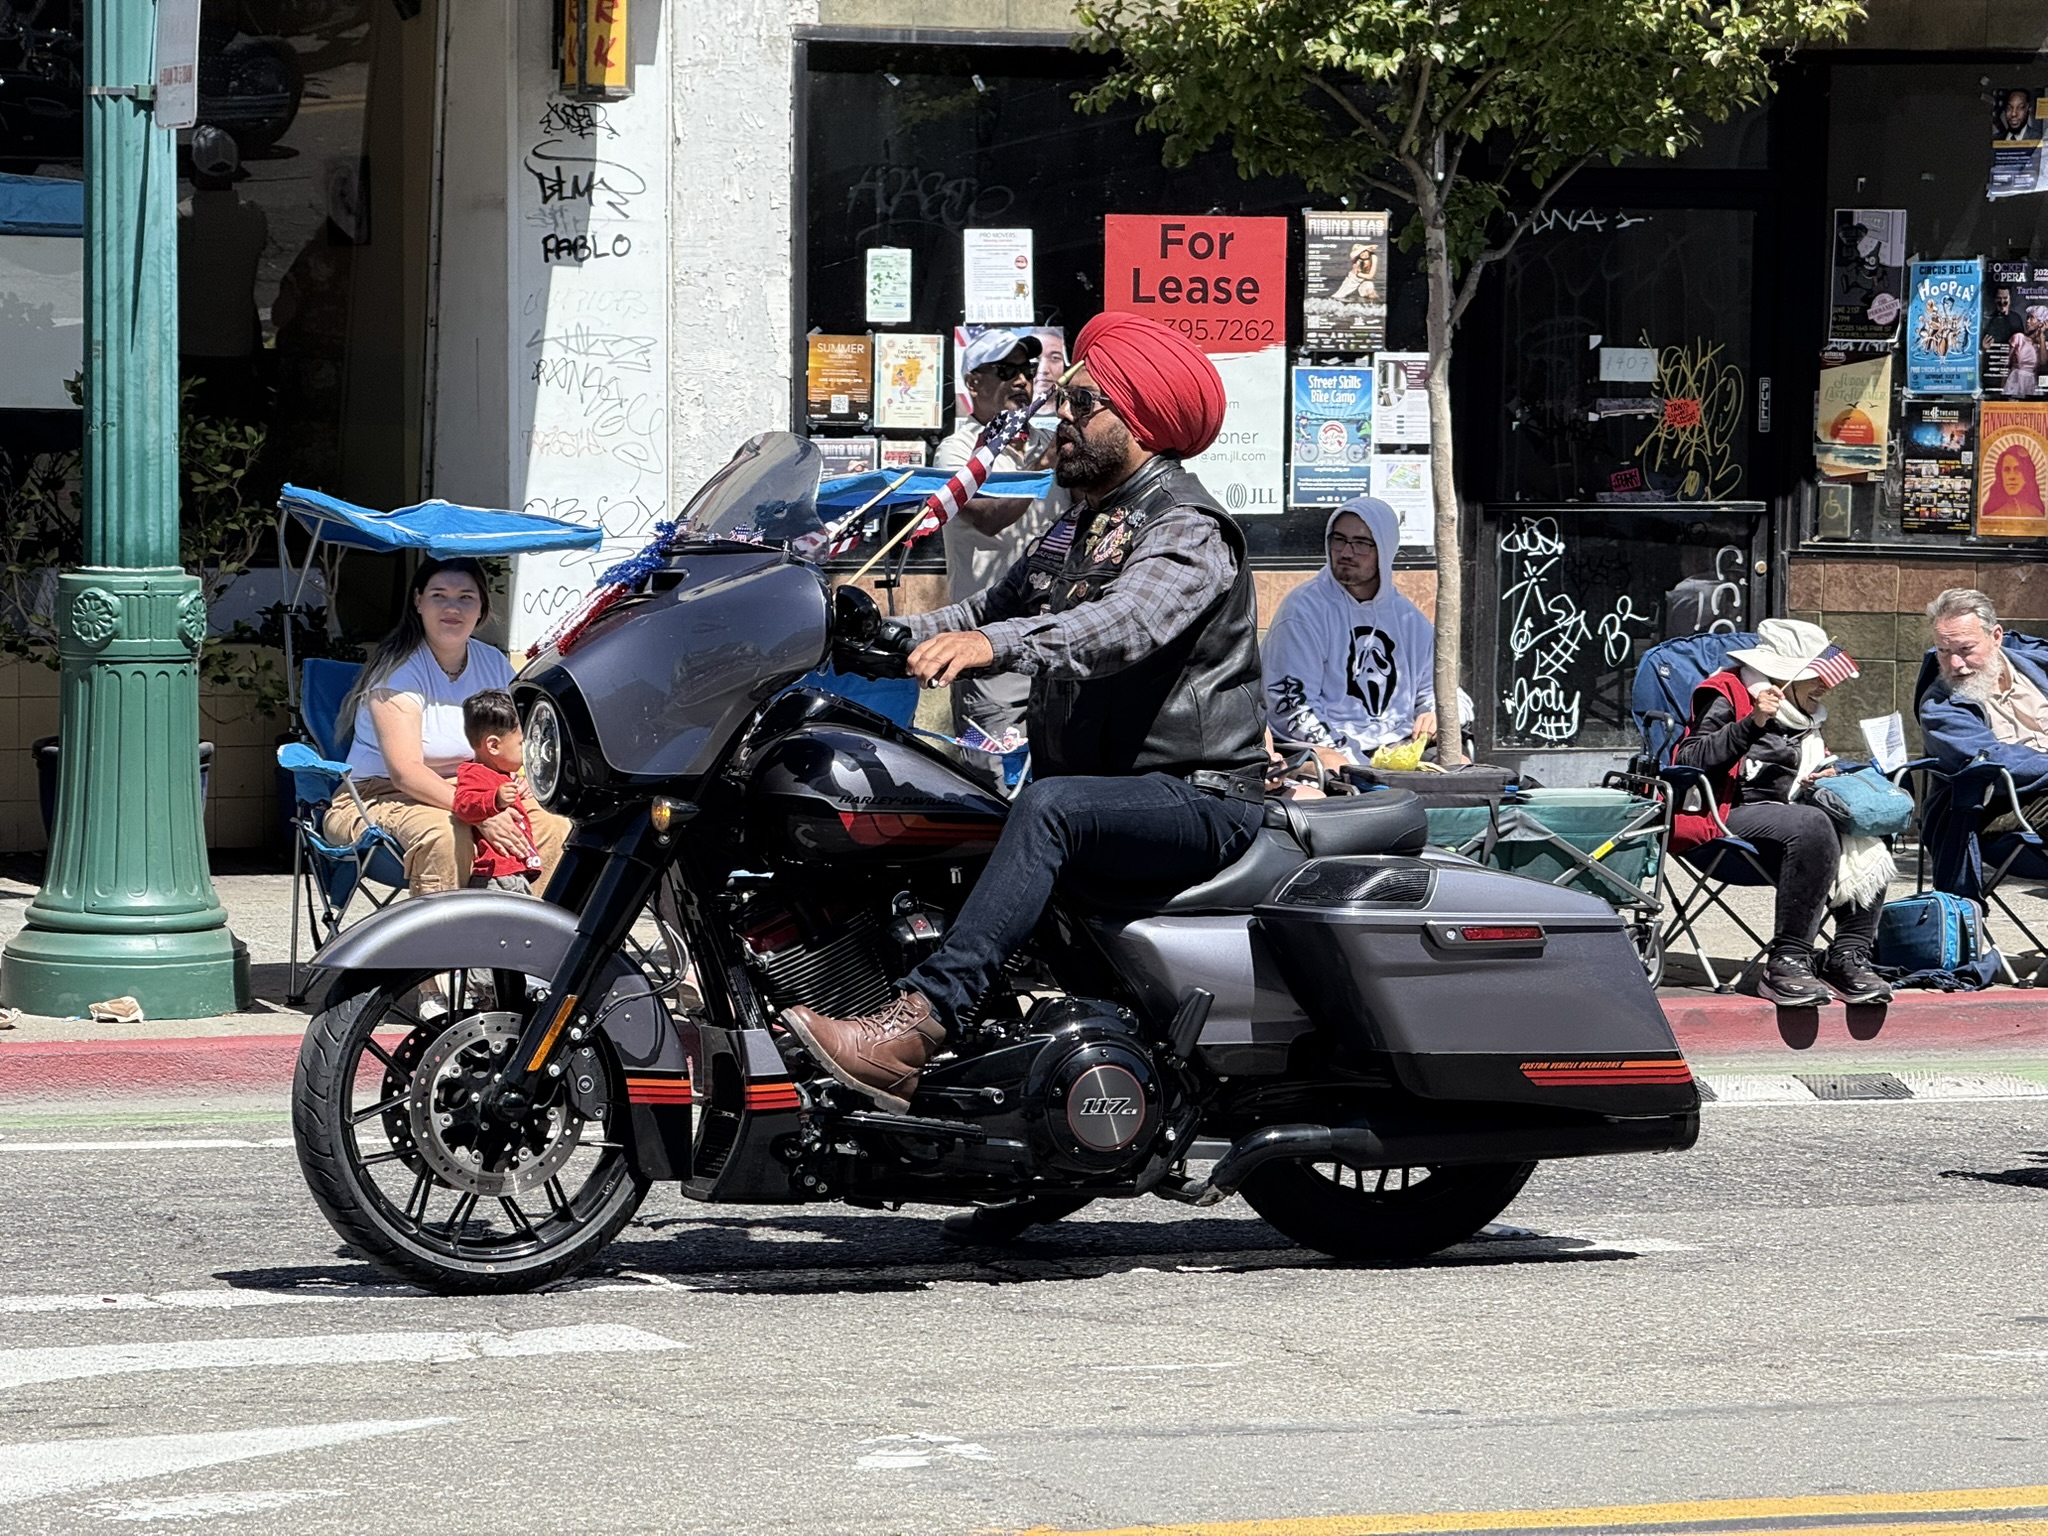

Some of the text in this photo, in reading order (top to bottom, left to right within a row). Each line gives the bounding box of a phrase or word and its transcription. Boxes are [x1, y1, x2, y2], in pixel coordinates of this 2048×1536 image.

[1308, 219, 1384, 231] RISING SEAS
[541, 233, 631, 263] PABLO
[1160, 224, 1234, 260] For
[1919, 265, 1973, 275] CIRCUS BELLA
[1988, 262, 2027, 273] POCKET
[1993, 272, 2026, 282] OPERA
[1132, 267, 1260, 305] Lease
[2016, 286, 2048, 295] Tartuffe
[817, 342, 864, 353] SUMMER
[1308, 374, 1362, 389] Street Skills
[1311, 389, 1356, 405] Bike Camp
[1761, 383, 1770, 419] PULL
[1983, 411, 2048, 440] ANNUNCIATION
[1249, 487, 1278, 504] JLL
[1519, 1061, 1621, 1070] CUSTOM VEHICLE OPERATIONS
